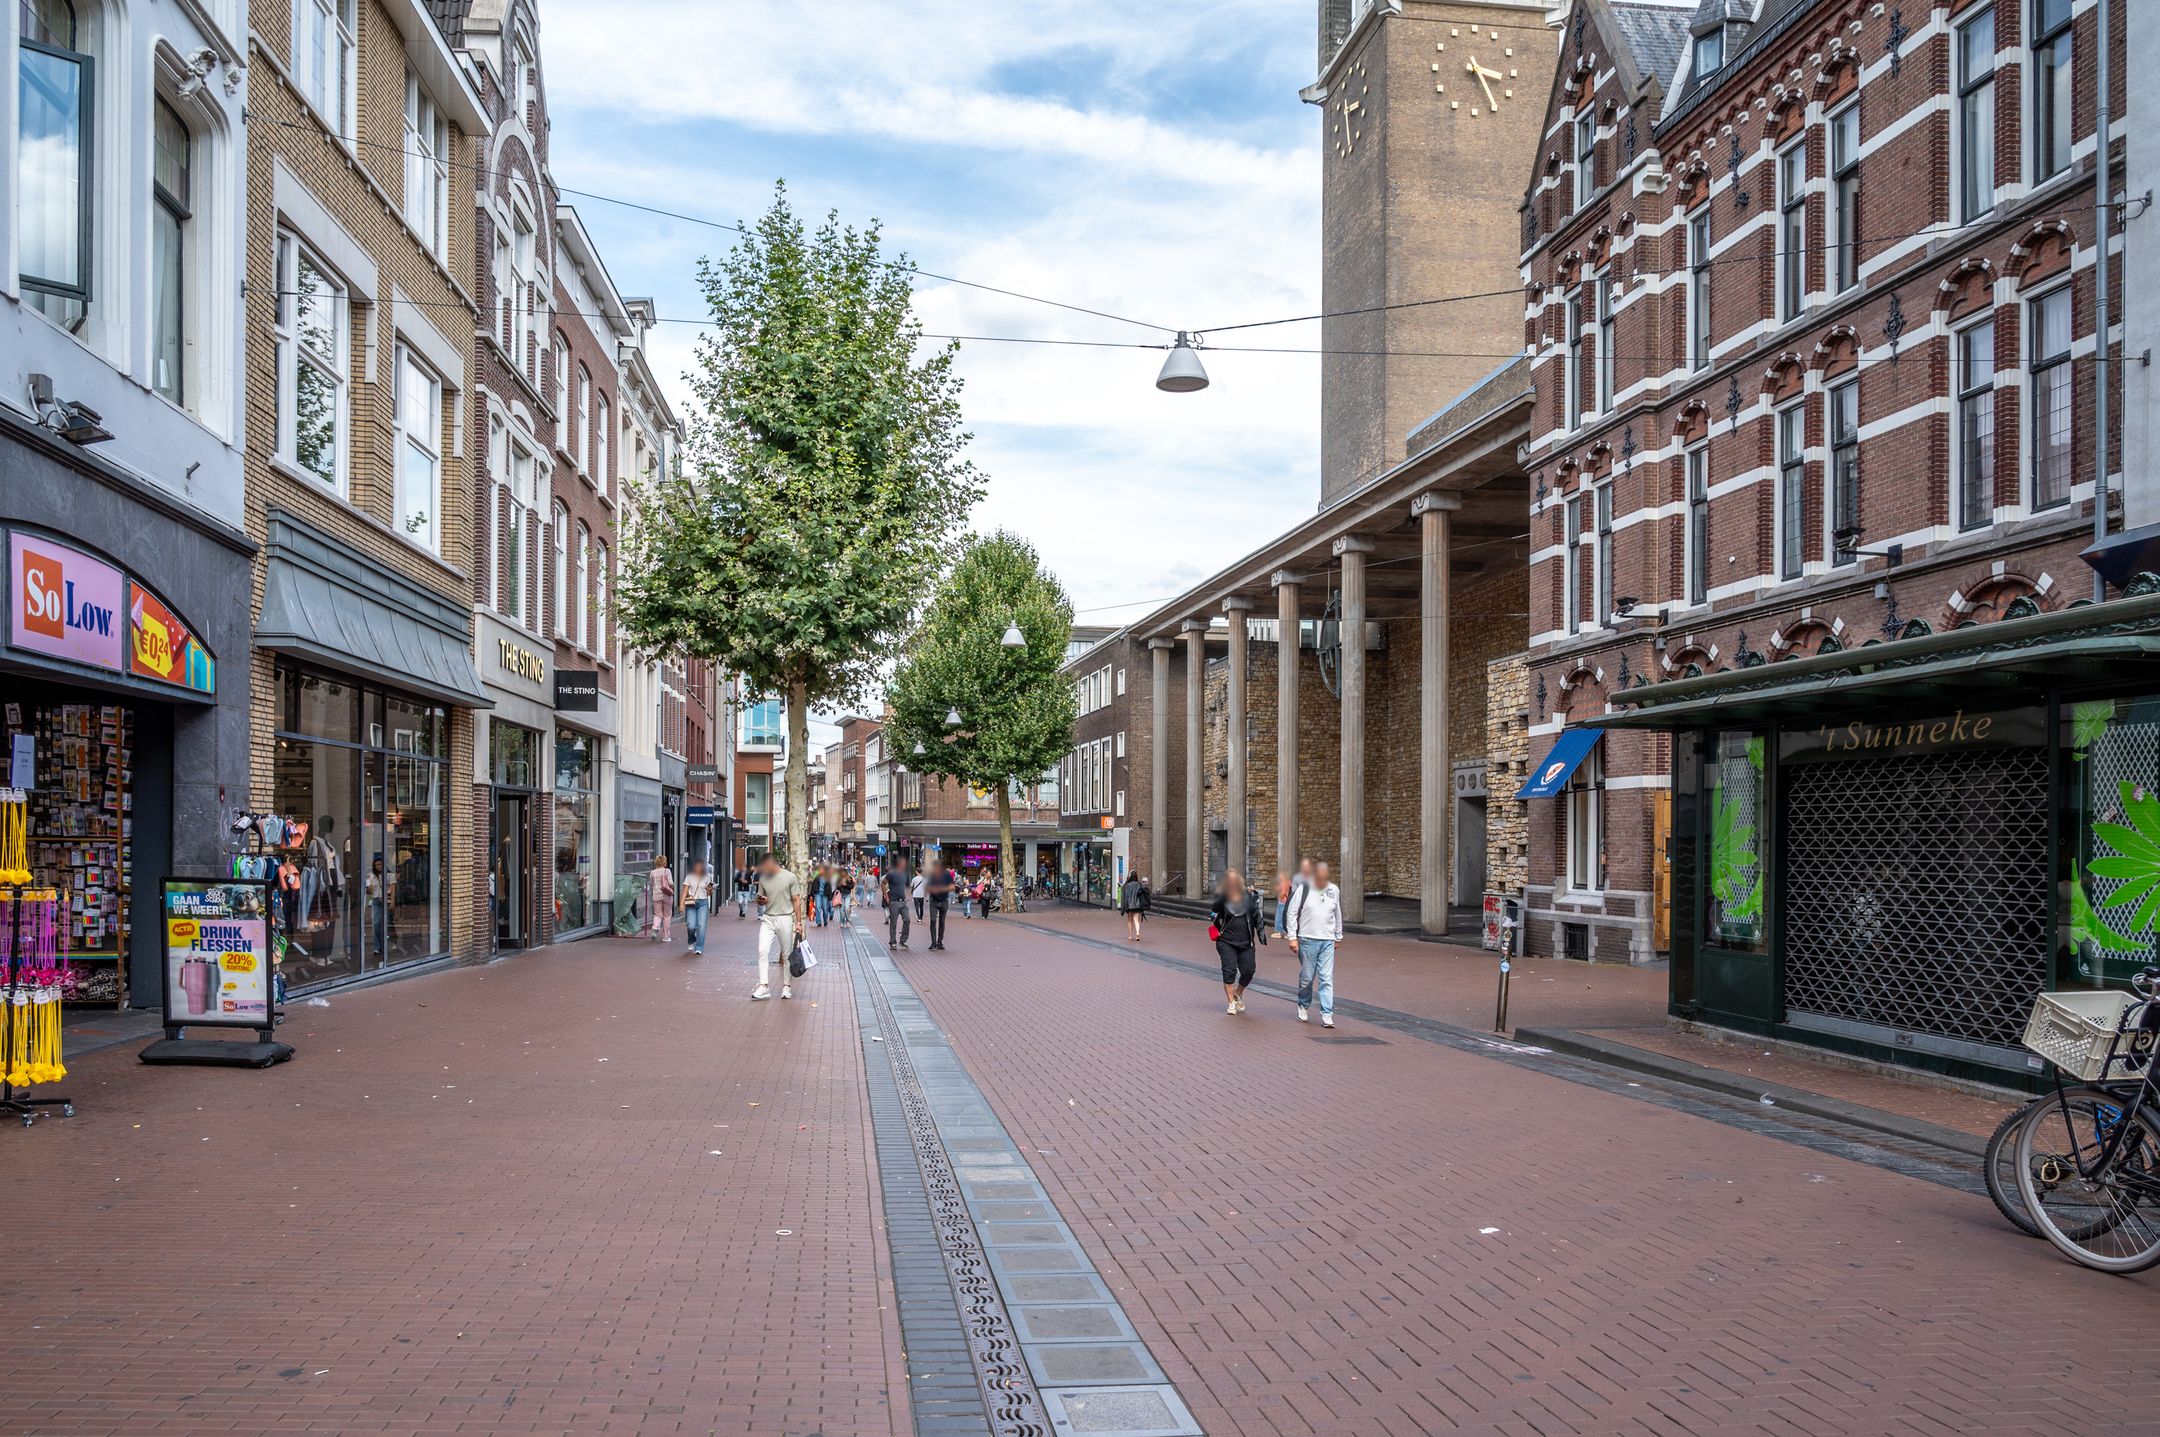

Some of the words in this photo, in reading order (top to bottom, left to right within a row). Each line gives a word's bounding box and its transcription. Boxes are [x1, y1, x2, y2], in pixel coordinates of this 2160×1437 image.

[499, 639, 517, 672] THE
[518, 648, 544, 684] STING
[558, 686, 572, 694] THE
[573, 687, 596, 695] STING
[1819, 724, 1837, 752] 't
[1843, 709, 1993, 751] Sunneke
[172, 895, 200, 905] GAAN
[173, 905, 189, 915] WE
[174, 925, 194, 933] ACTIE
[199, 926, 243, 939] DRINK
[226, 953, 252, 966] 20%
[226, 964, 250, 972] KORTING
